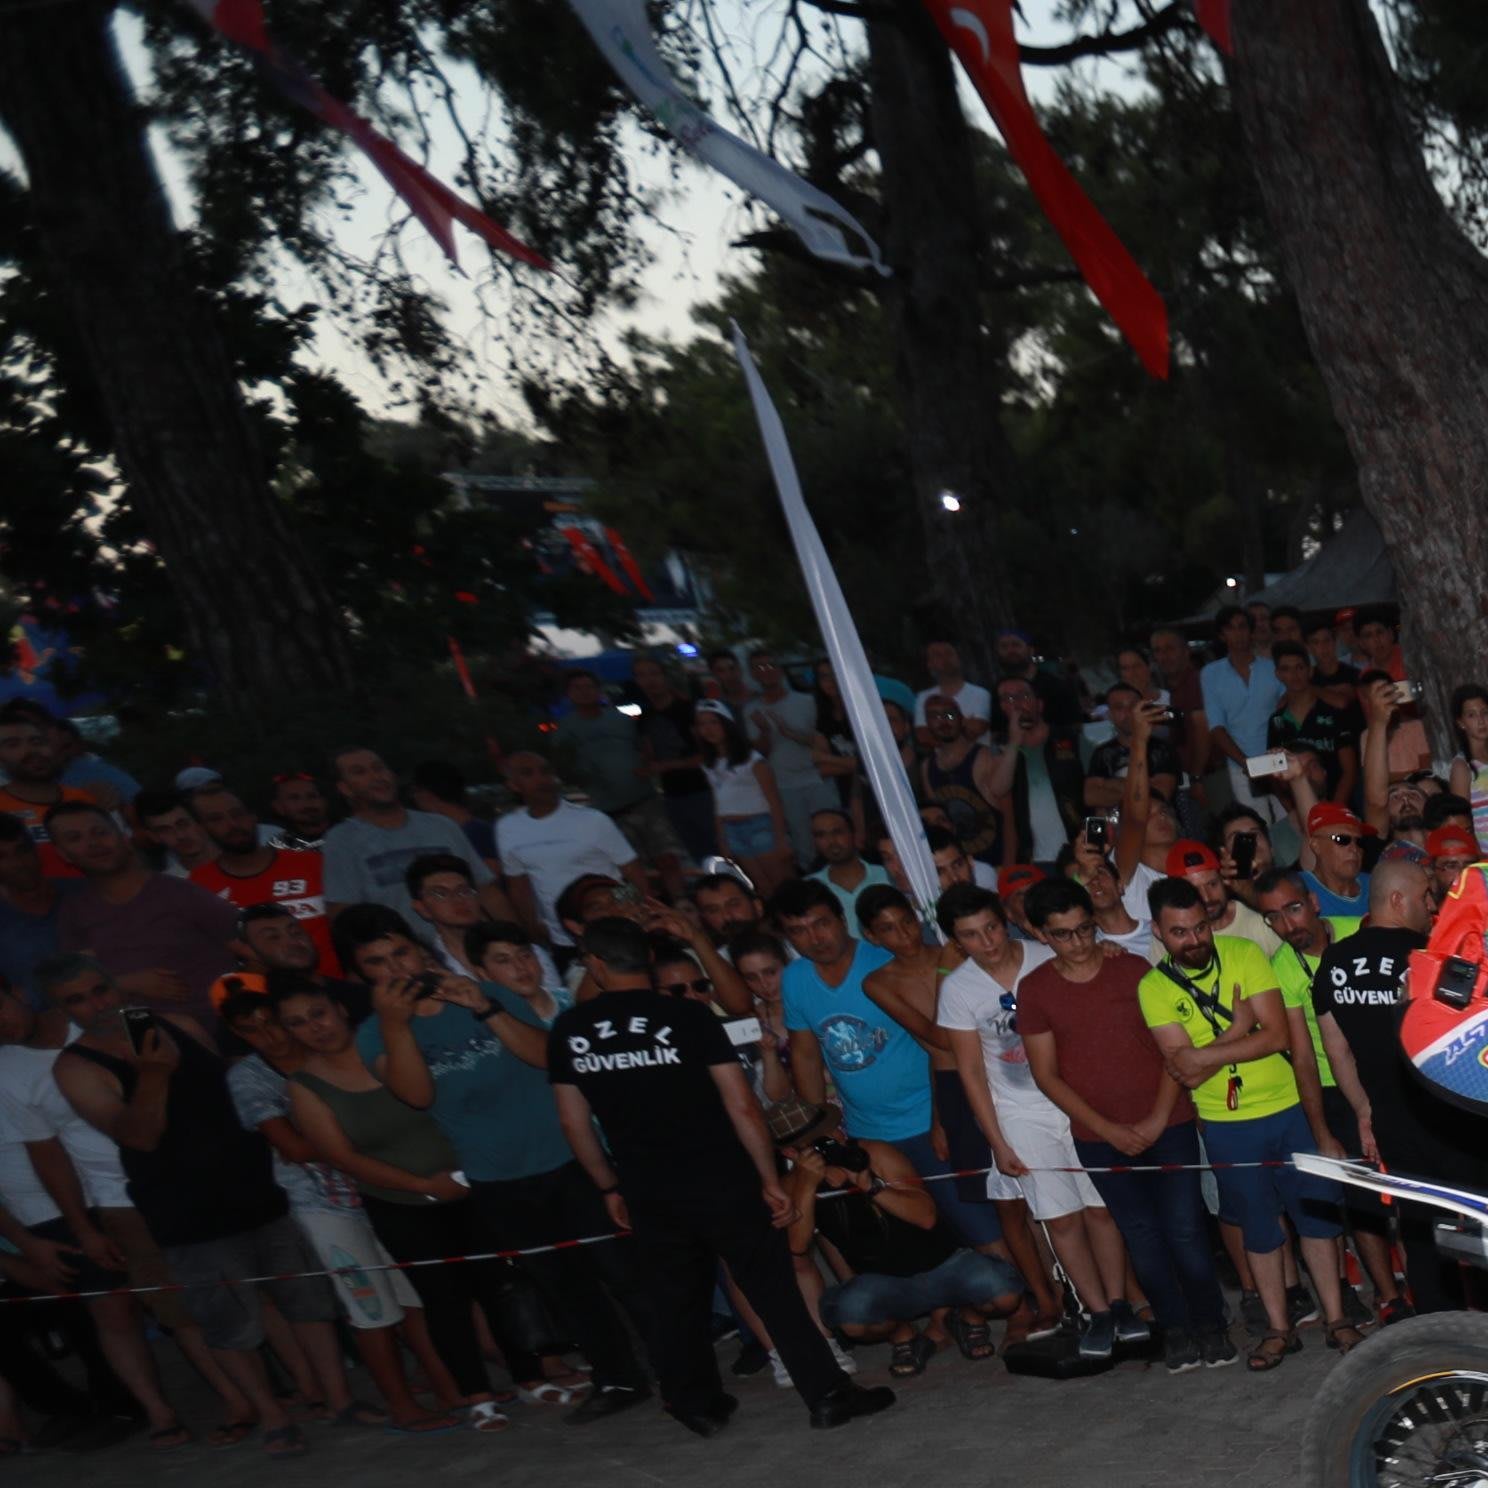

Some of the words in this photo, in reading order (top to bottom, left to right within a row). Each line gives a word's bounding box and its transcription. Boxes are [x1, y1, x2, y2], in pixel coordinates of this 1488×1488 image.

[272, 879, 307, 897] 93
[1333, 986, 1401, 1005] GÜVENL
[568, 1016, 673, 1054] ÖZEL
[572, 1045, 683, 1074] GÜVENLİK
